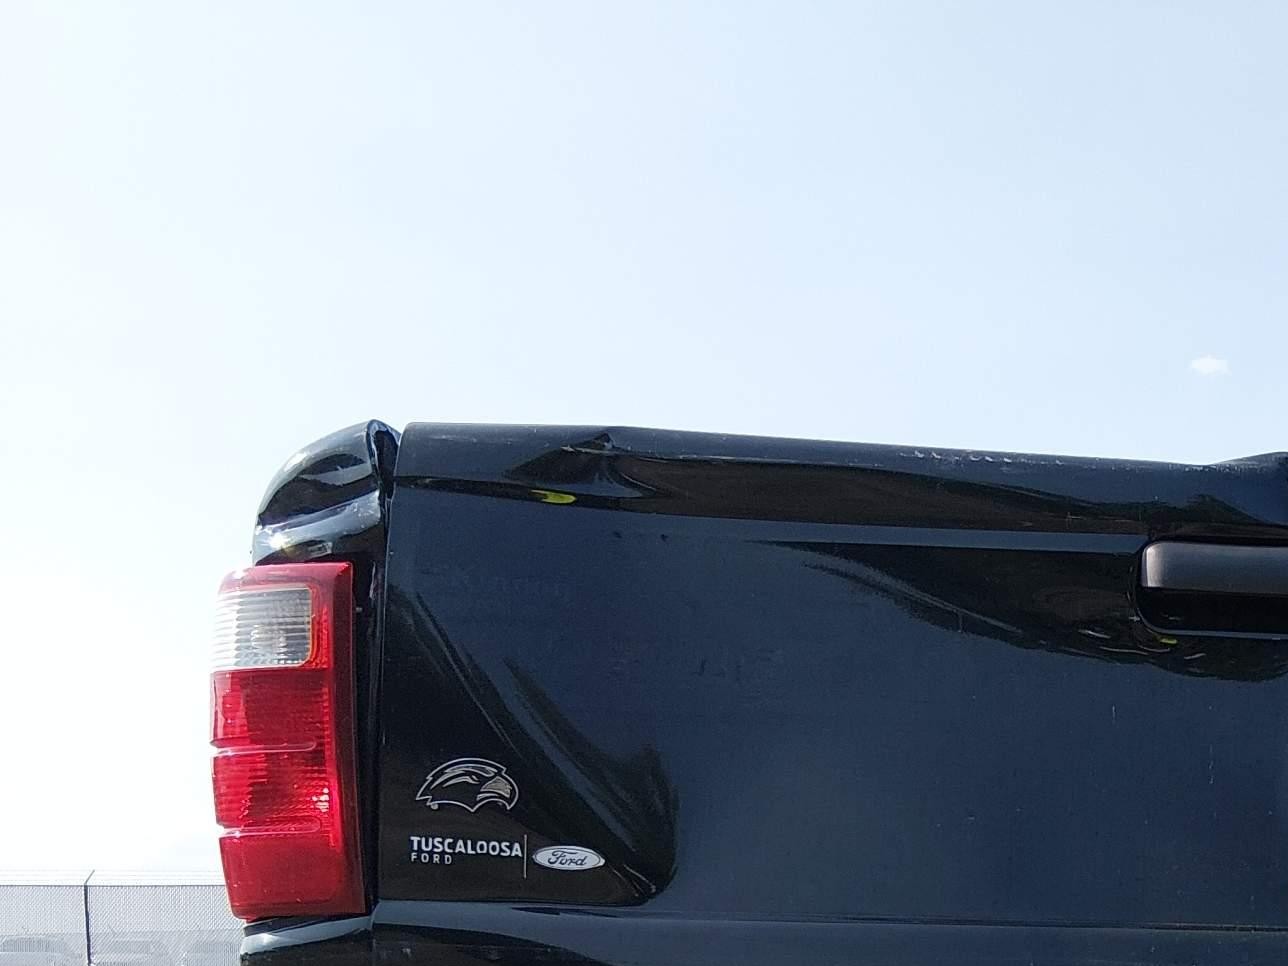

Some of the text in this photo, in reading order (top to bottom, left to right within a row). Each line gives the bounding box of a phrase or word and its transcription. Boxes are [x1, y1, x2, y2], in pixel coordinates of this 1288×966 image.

[410, 836, 522, 858] TUSCALOOSA
[411, 852, 452, 865] FORD
[547, 850, 587, 867] Ford
